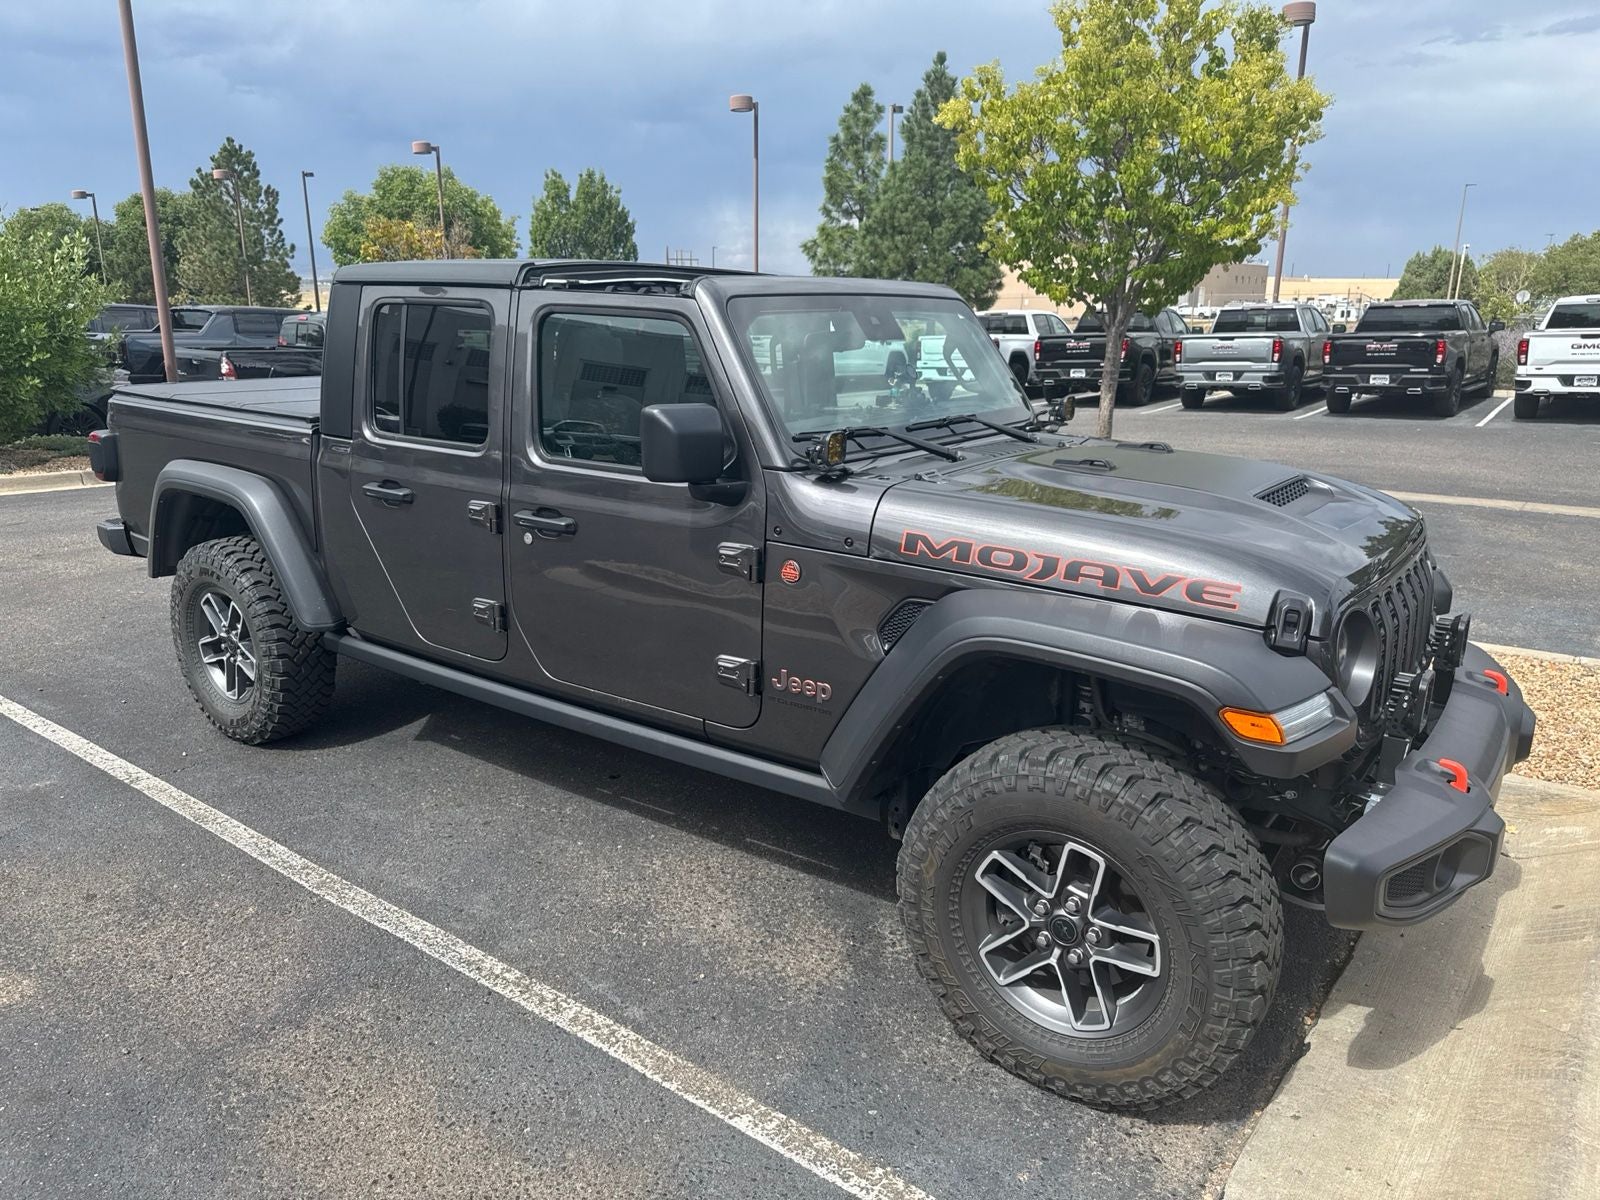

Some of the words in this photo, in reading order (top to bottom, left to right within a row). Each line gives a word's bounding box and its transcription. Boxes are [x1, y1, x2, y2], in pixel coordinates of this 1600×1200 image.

[900, 529, 1242, 612] MOJAVE
[771, 669, 832, 703] Jeep
[1136, 848, 1208, 1041] FALKEN
